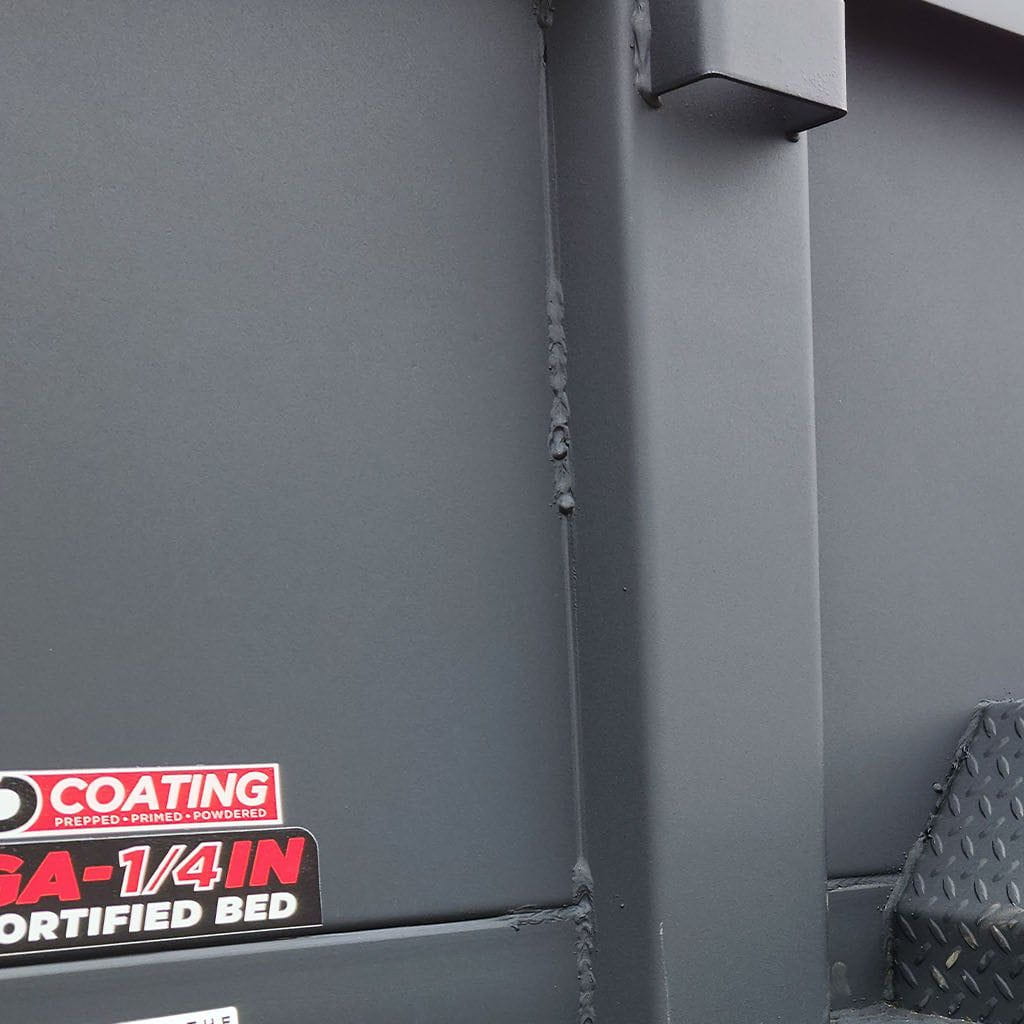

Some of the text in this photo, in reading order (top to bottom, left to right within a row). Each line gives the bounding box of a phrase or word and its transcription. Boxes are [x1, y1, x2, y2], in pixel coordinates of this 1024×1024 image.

[50, 771, 269, 814] COATING
[55, 808, 267, 828] PREPPED PRIMED POWDERED
[215, 892, 298, 925] BED
